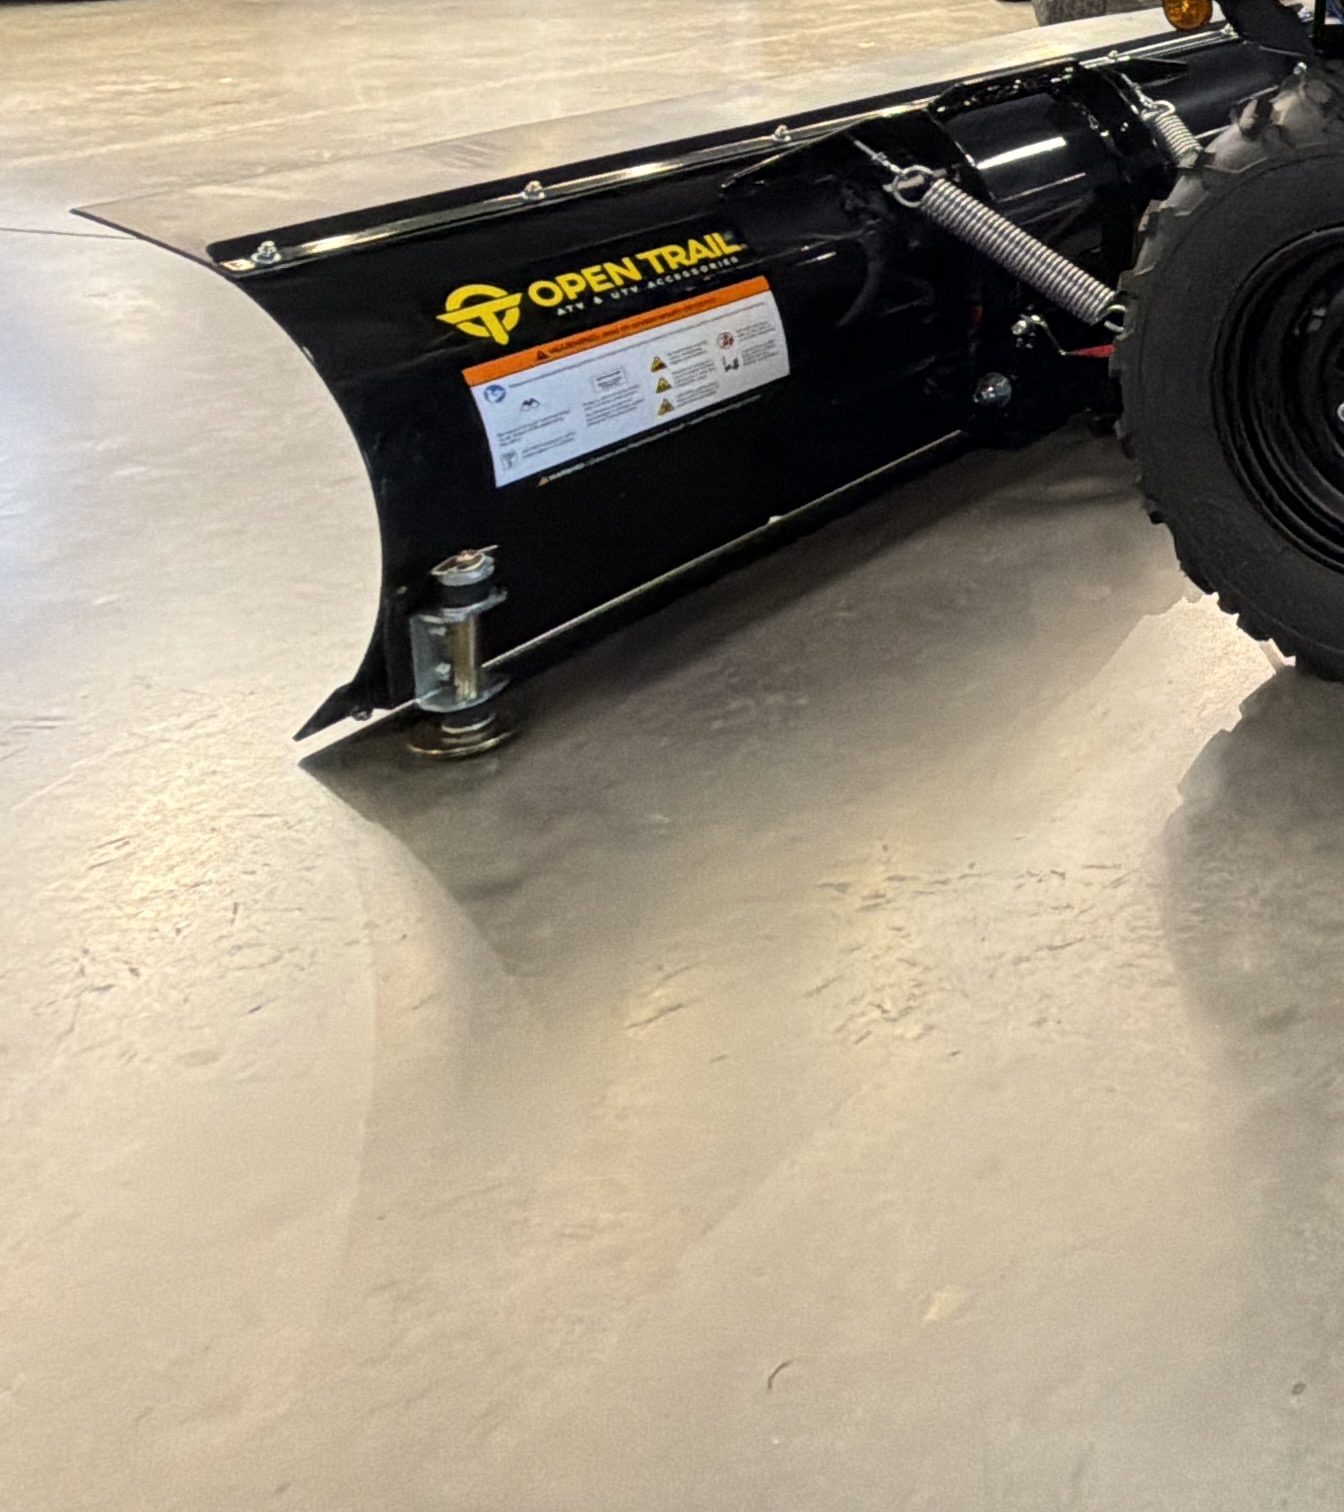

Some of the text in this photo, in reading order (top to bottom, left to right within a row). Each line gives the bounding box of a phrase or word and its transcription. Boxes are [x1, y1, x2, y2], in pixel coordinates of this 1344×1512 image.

[528, 232, 743, 307] OPEN TRAIL
[557, 301, 585, 317] ATV
[610, 285, 639, 301] UTV
[647, 255, 740, 290] ACCESSORIES
